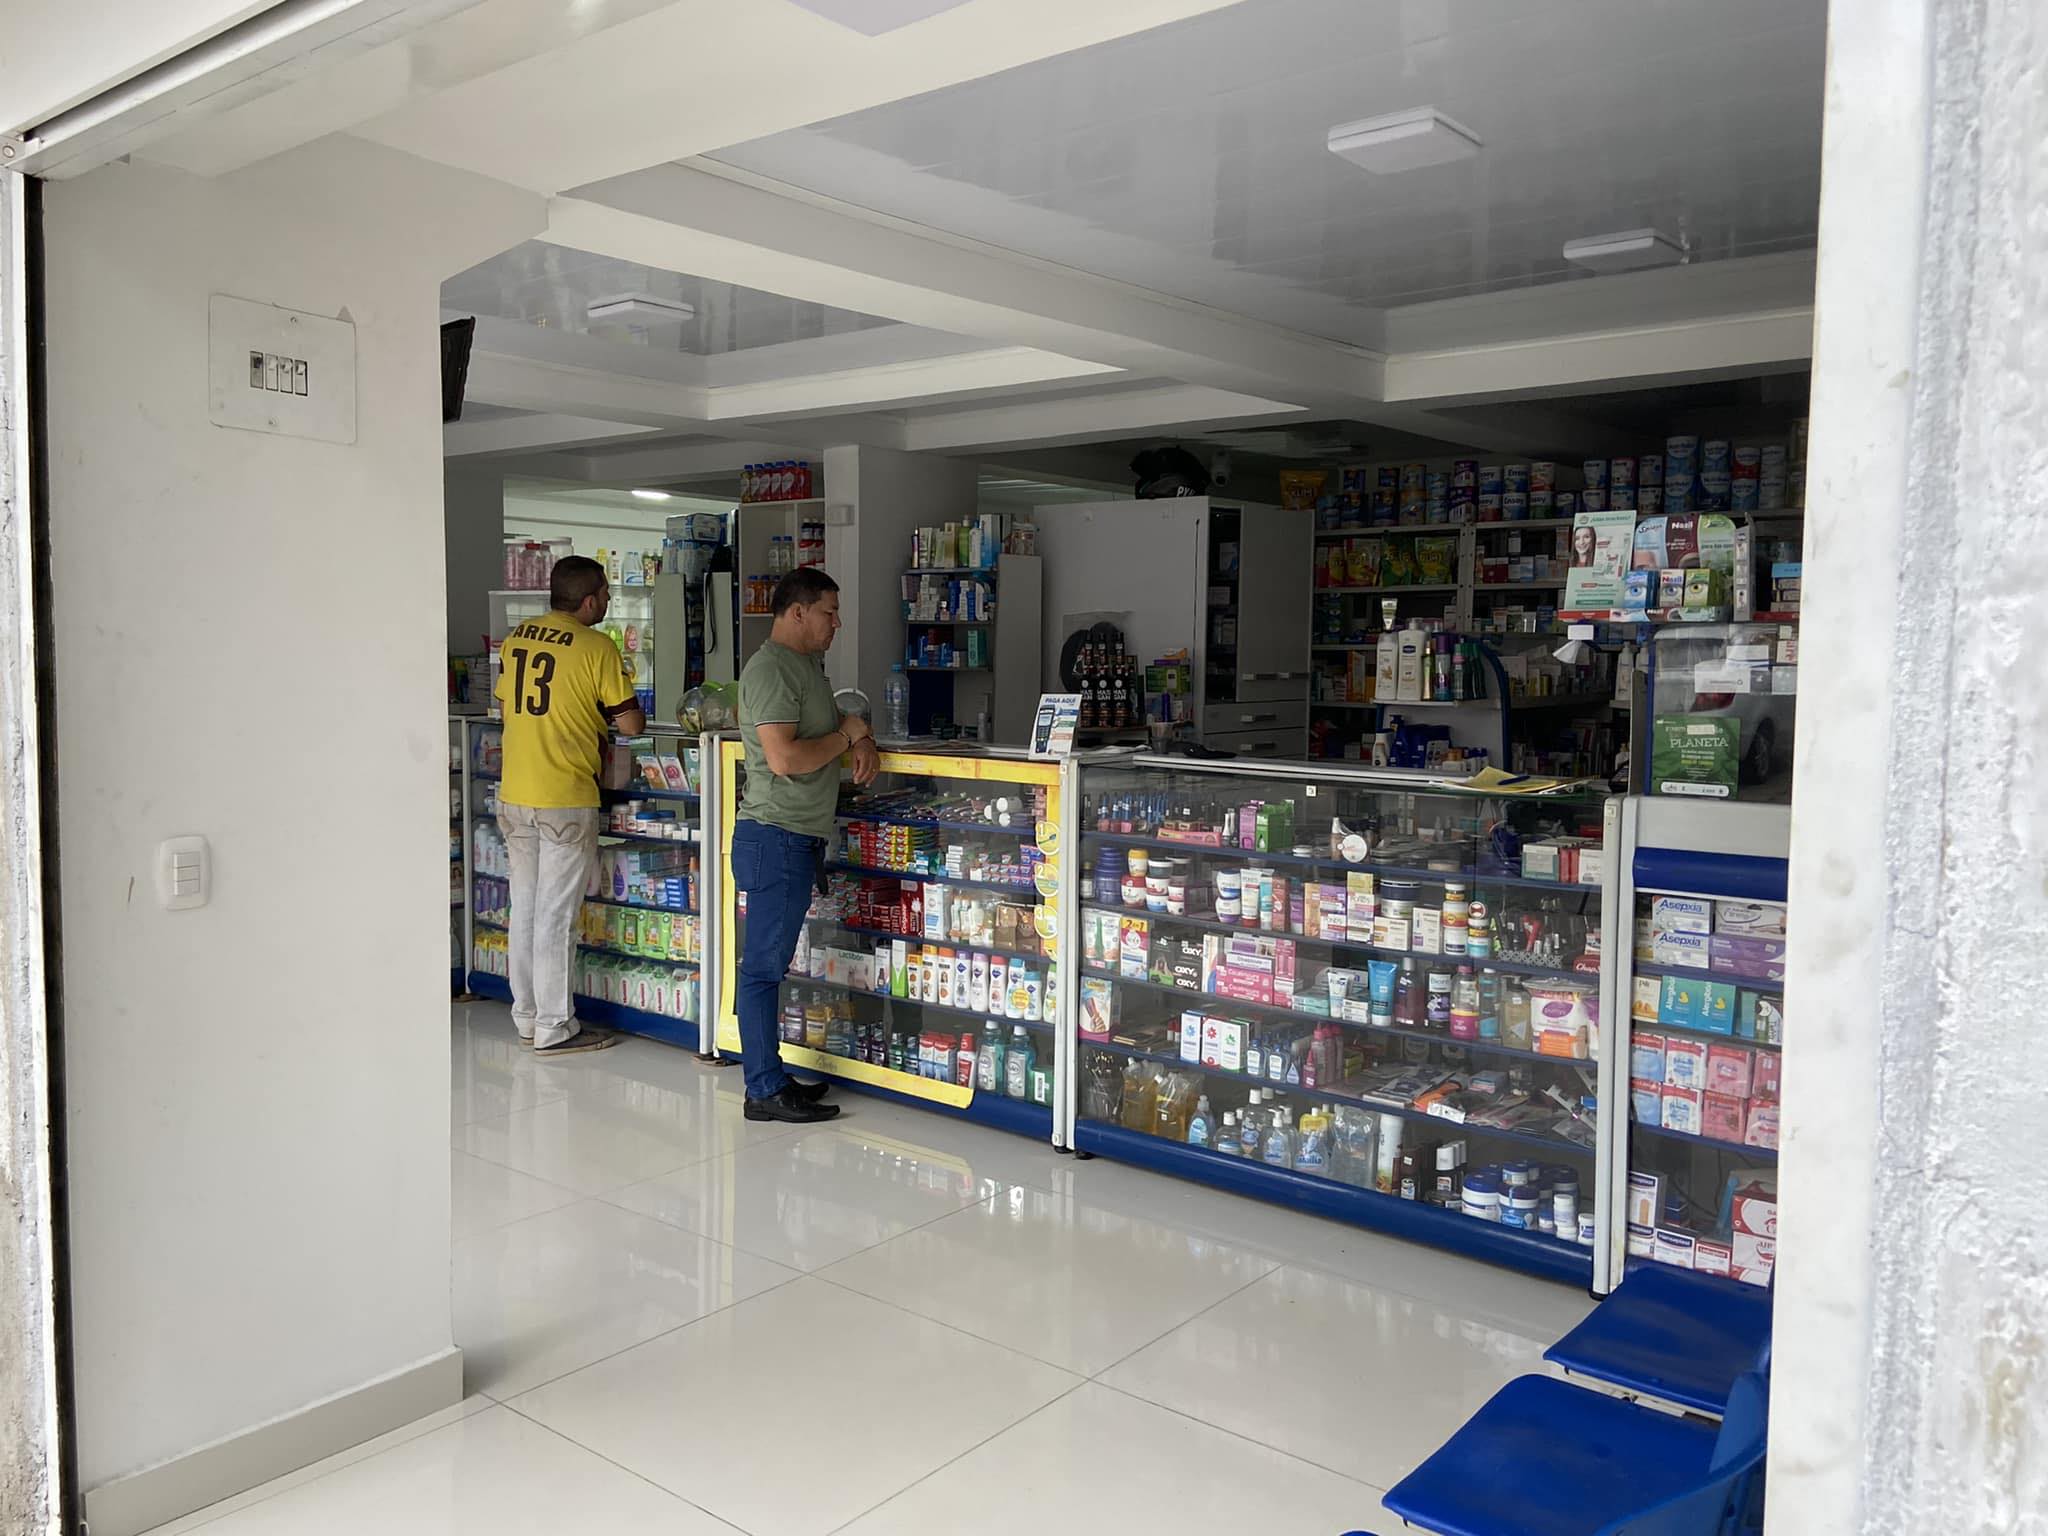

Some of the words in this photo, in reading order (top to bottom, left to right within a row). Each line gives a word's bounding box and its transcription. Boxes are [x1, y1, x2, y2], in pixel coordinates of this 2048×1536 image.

[512, 624, 574, 646] ARIZA
[511, 648, 556, 716] 13
[1670, 737, 1729, 748] PLANETA
[1660, 899, 1702, 913] Asepxia
[1659, 932, 1701, 947] Asepxia
[1182, 947, 1202, 956] OXY
[1175, 966, 1194, 975] OXY
[1176, 978, 1196, 988] OXY
